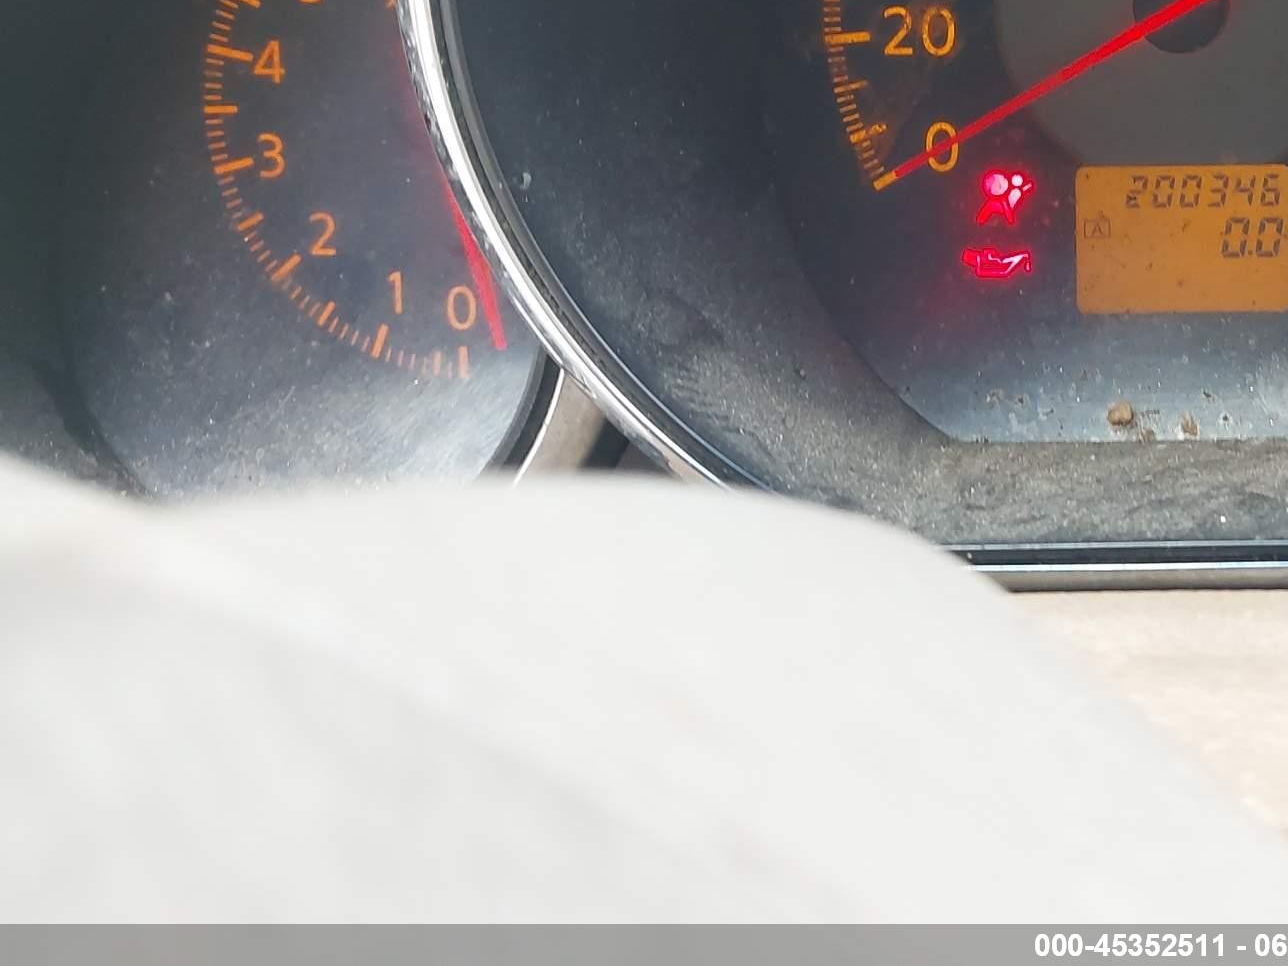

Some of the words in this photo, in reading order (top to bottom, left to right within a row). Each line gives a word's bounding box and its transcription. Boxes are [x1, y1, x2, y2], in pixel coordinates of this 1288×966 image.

[883, 6, 957, 58] 20
[252, 39, 287, 85] 4
[256, 133, 286, 180] 3
[924, 120, 961, 174] 0
[1126, 173, 1281, 208] 200346
[309, 211, 338, 257] 2
[1222, 217, 1284, 257] 0.0
[386, 271, 403, 314] 1
[446, 284, 478, 331] 0
